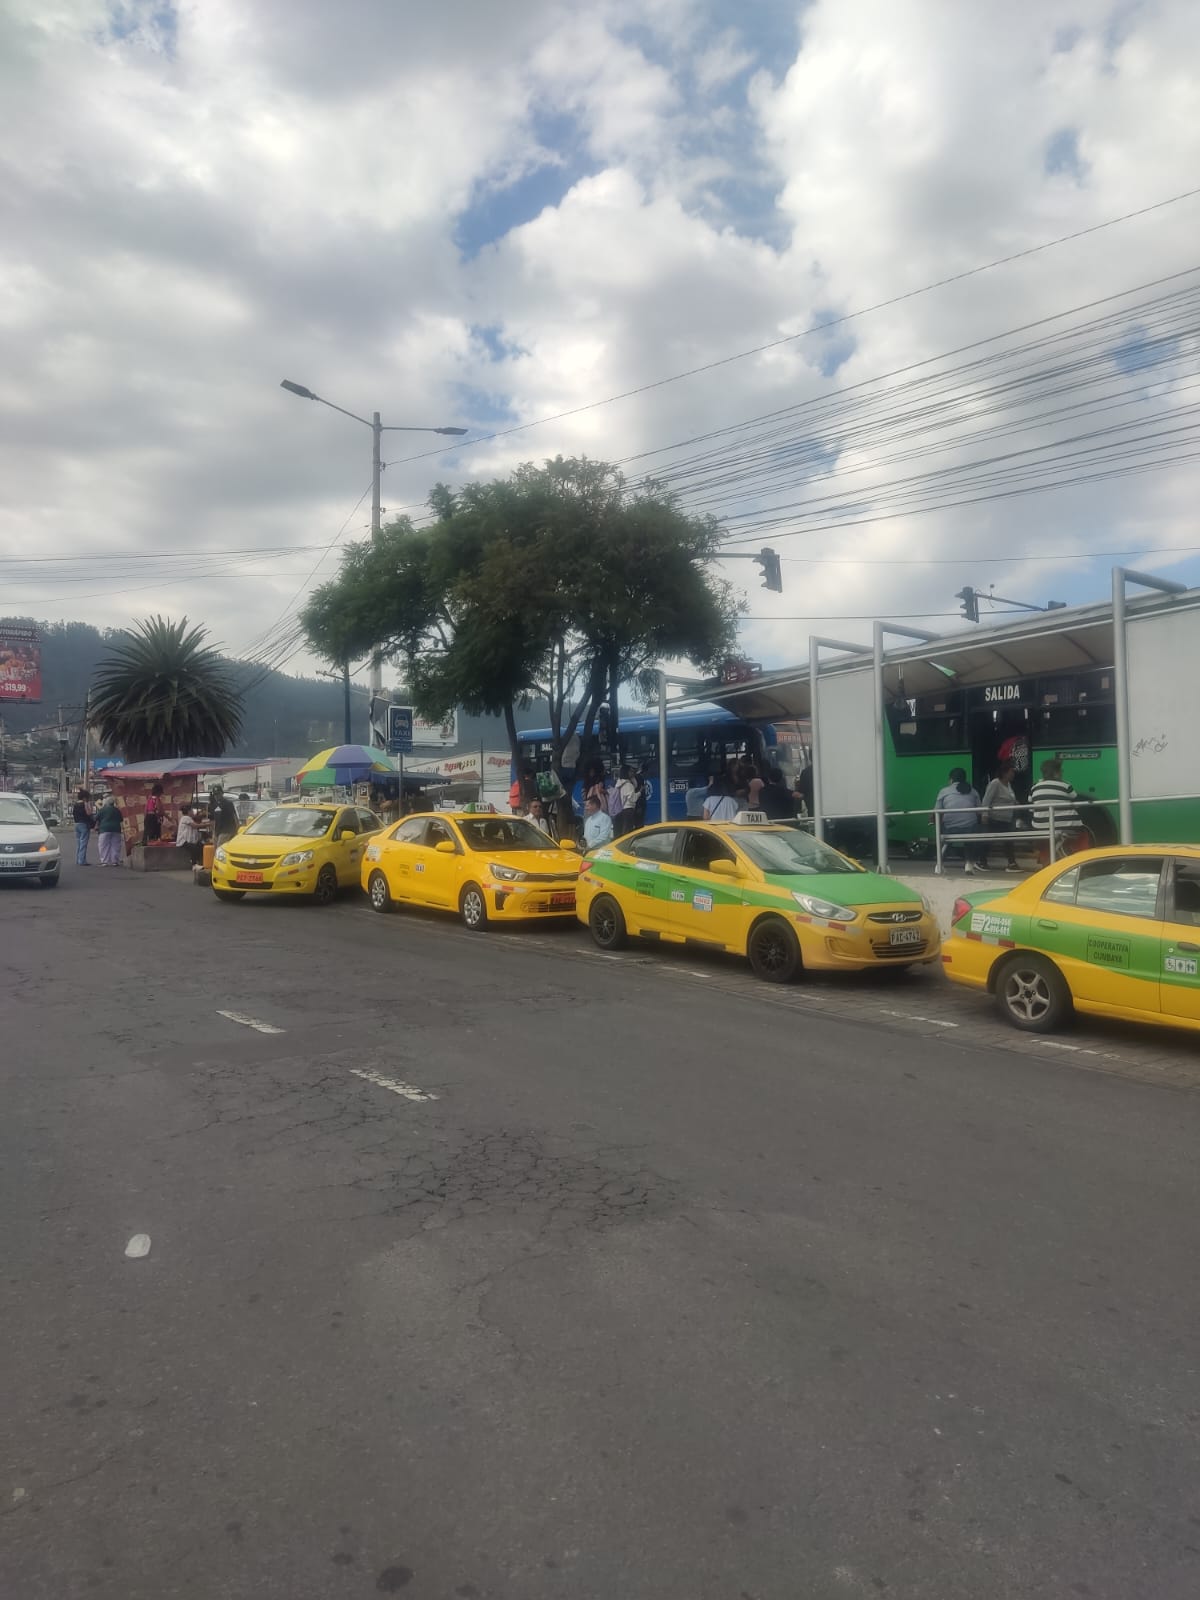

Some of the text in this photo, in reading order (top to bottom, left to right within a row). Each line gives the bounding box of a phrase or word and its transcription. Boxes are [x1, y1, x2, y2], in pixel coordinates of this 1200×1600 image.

[985, 685, 1020, 701] SALIDA
[476, 804, 491, 812] TAXI
[747, 814, 762, 823] TAXI
